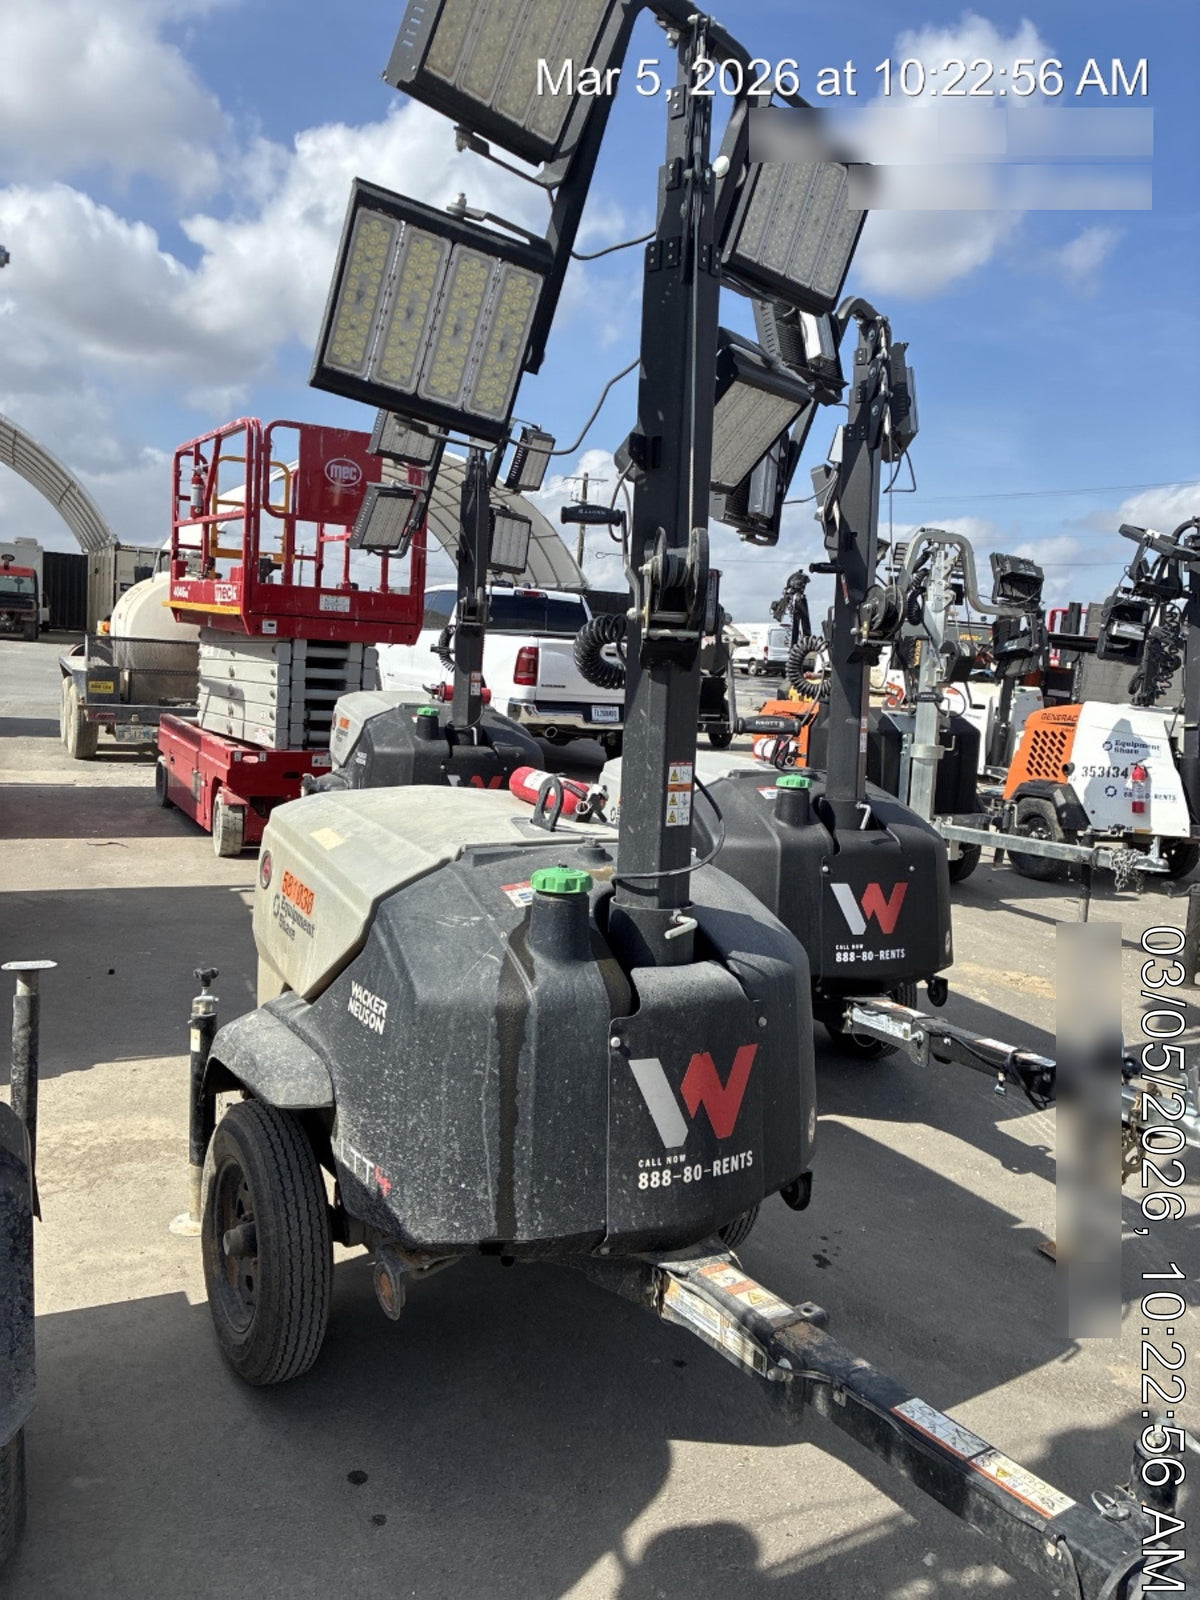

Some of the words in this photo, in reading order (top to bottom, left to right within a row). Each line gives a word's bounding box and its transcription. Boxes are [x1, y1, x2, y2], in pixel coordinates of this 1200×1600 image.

[1041, 713, 1078, 722] GENERAC
[1114, 740, 1160, 751] Equipment
[1082, 766, 1129, 778] 353134
[835, 948, 906, 962] 888-80-RENTS
[351, 980, 388, 1019] WACKER
[347, 996, 386, 1036] NEUSON
[638, 1156, 662, 1168] CALL
[666, 1154, 686, 1165] NOW
[638, 1150, 753, 1190] 888-80-RENTS
